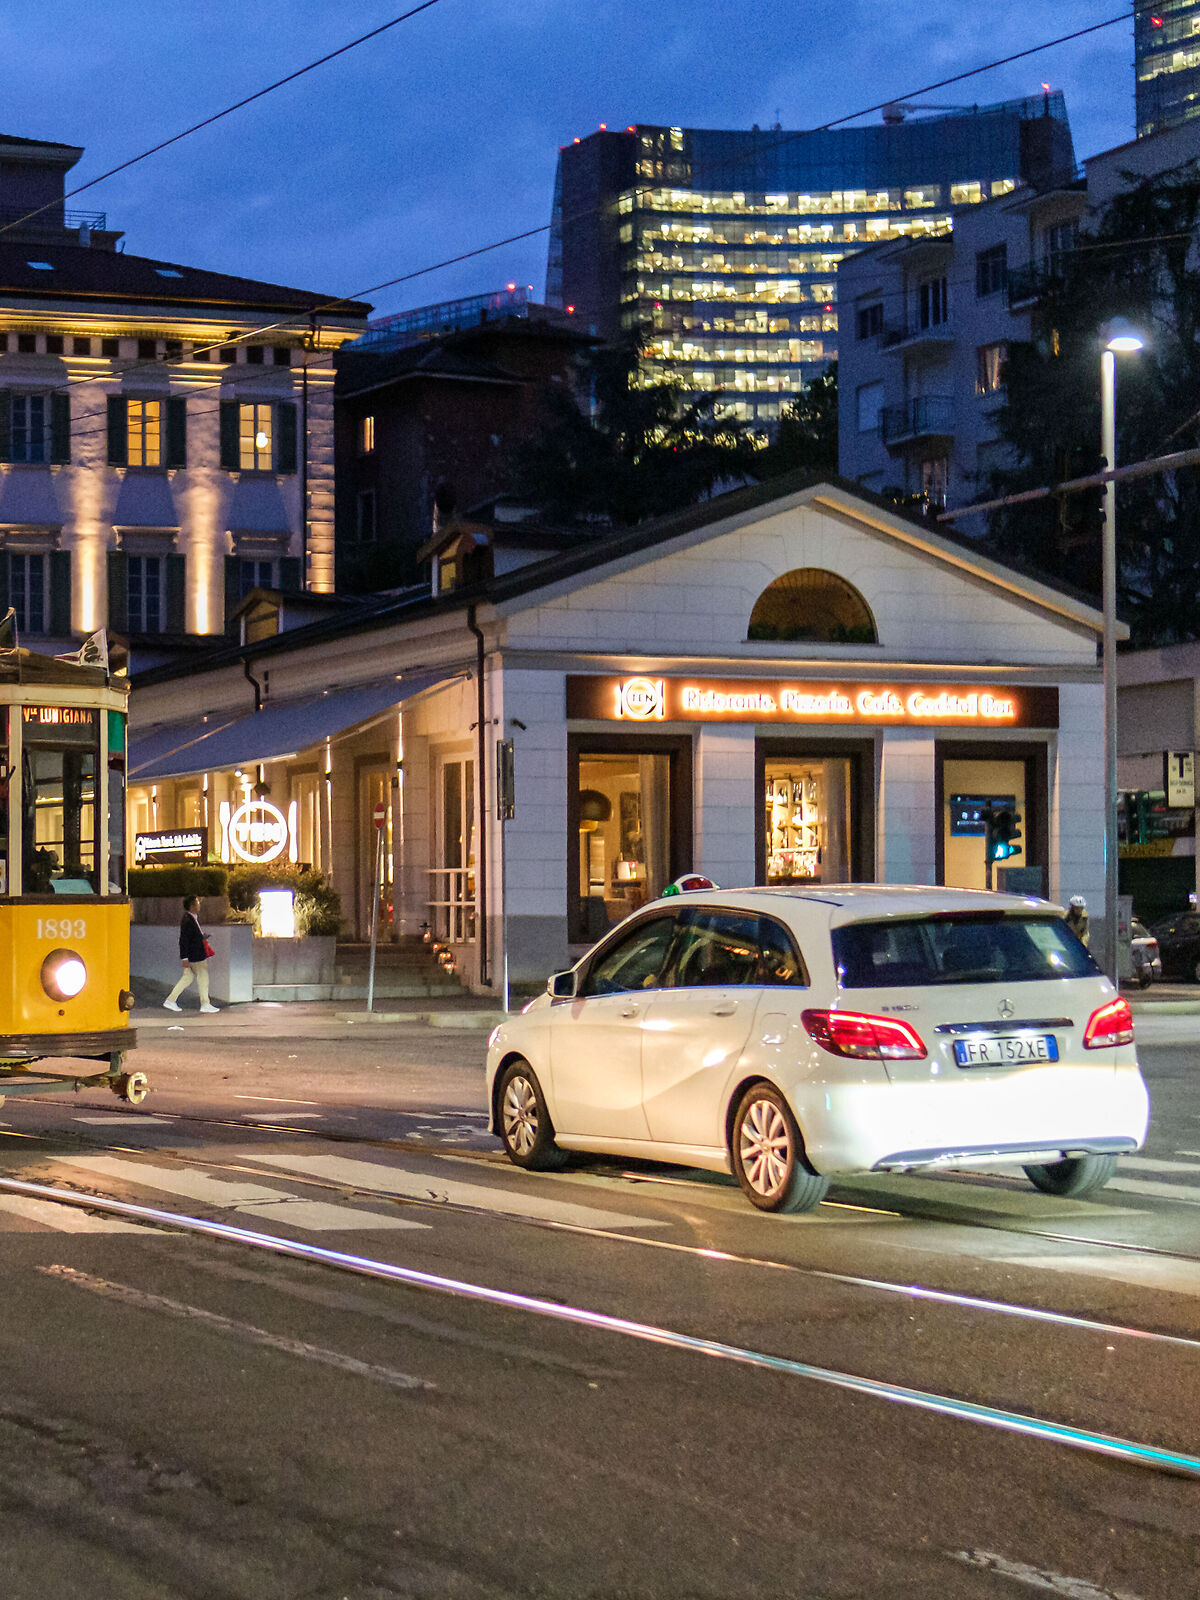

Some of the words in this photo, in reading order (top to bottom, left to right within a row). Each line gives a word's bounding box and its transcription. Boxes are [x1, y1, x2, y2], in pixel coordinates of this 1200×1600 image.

[632, 693, 653, 703] TEN
[39, 708, 93, 724] LUNIGIANA
[1173, 753, 1189, 778] T
[236, 822, 282, 843] TEN
[36, 919, 86, 939] 1893
[968, 1044, 989, 1062] FR
[998, 1040, 1046, 1060] 152XE
